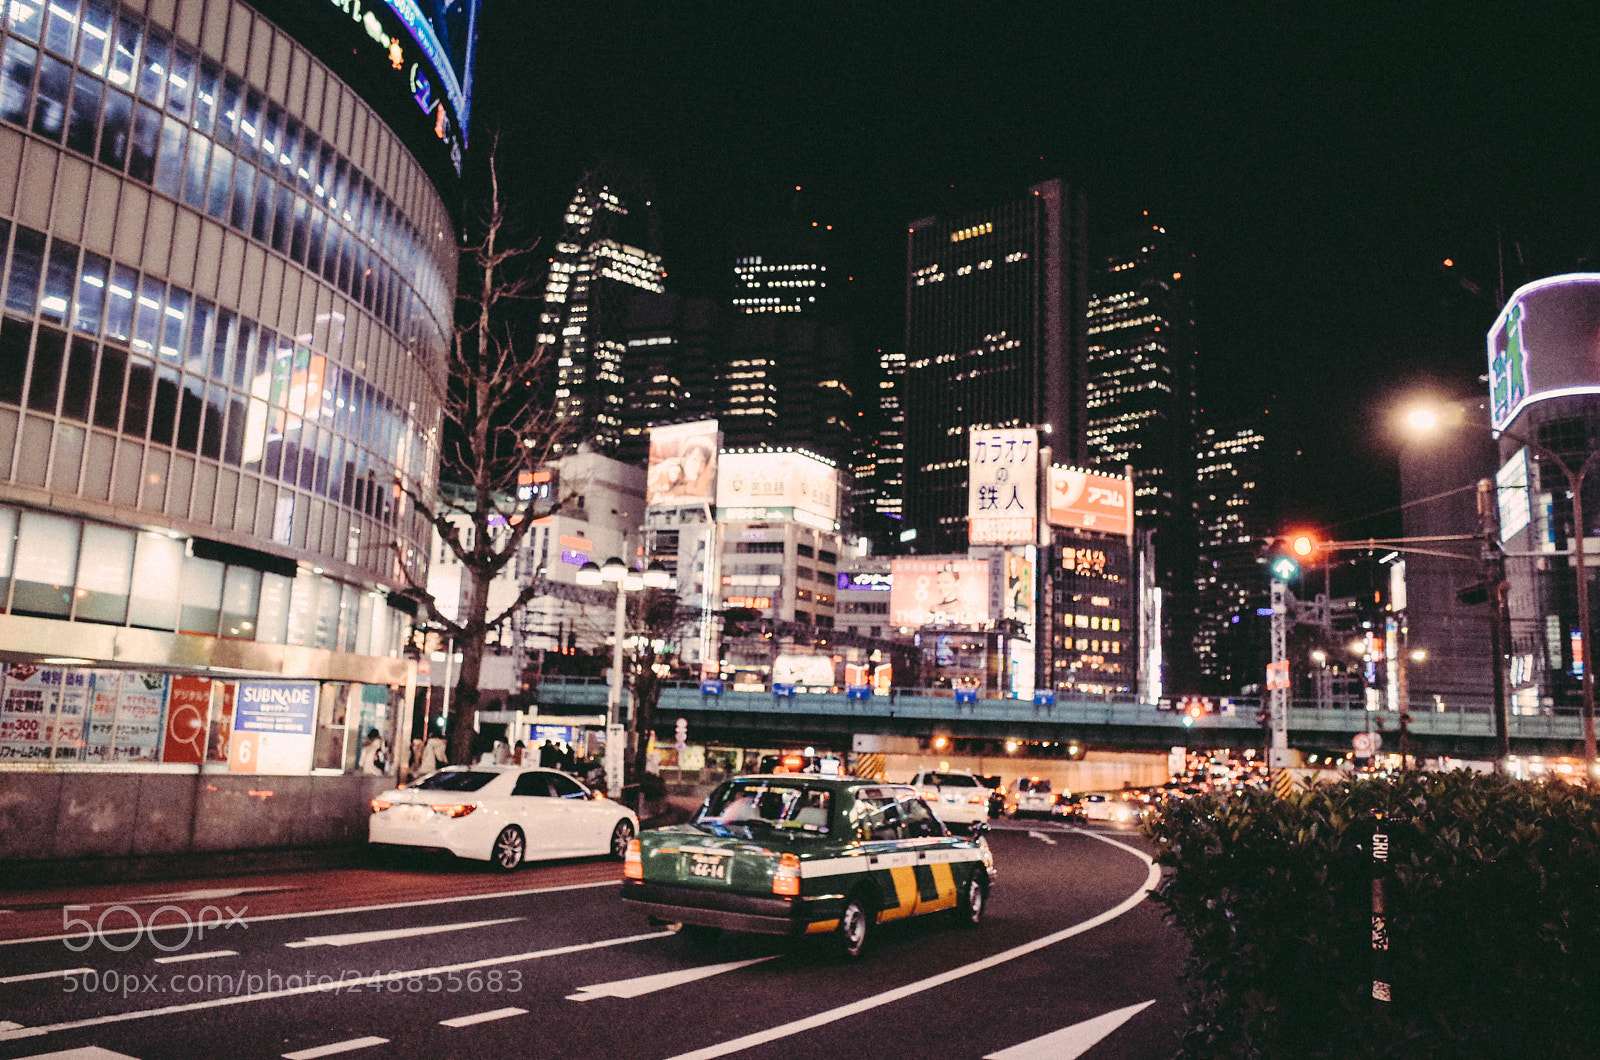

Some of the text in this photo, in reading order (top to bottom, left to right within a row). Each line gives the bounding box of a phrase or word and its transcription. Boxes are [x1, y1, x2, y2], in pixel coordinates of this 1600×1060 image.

[975, 436, 1032, 463] カラオケ
[996, 467, 1009, 482] の
[979, 485, 1024, 510] 鉄人
[243, 687, 311, 705] SUBNADE
[239, 739, 252, 764] 6
